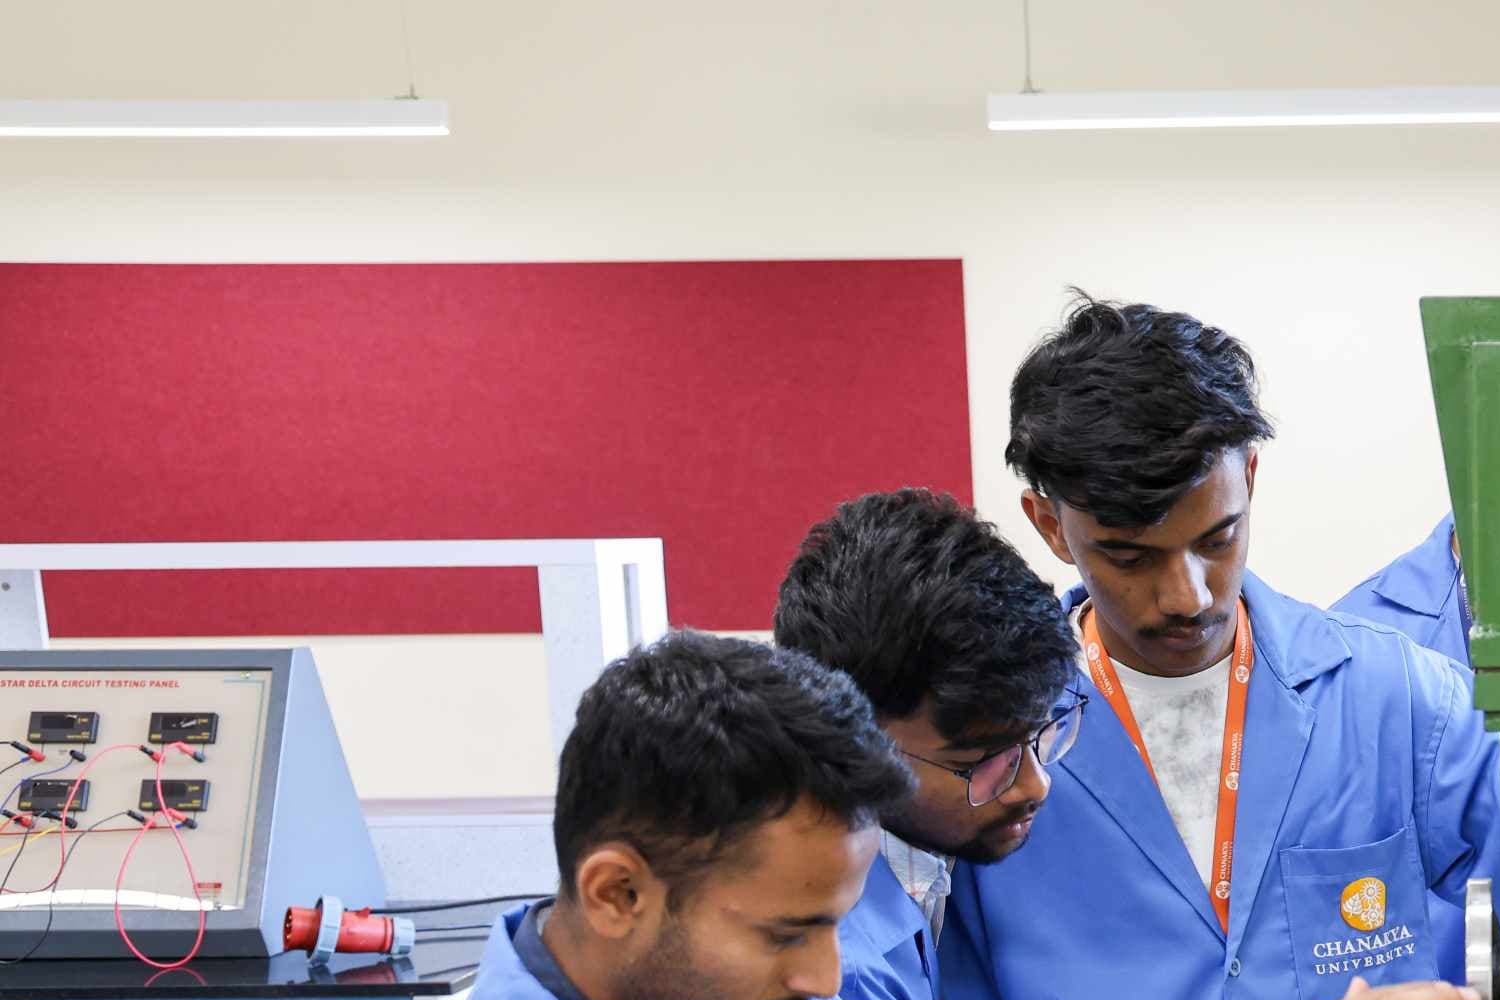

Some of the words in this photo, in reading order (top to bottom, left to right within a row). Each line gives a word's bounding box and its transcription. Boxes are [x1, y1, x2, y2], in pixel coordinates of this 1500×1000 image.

[0, 679, 25, 688] STAR
[28, 679, 58, 688] DELTA
[61, 679, 102, 688] CIRCUIT
[104, 680, 146, 688] TESTING
[149, 680, 181, 688] PANEL
